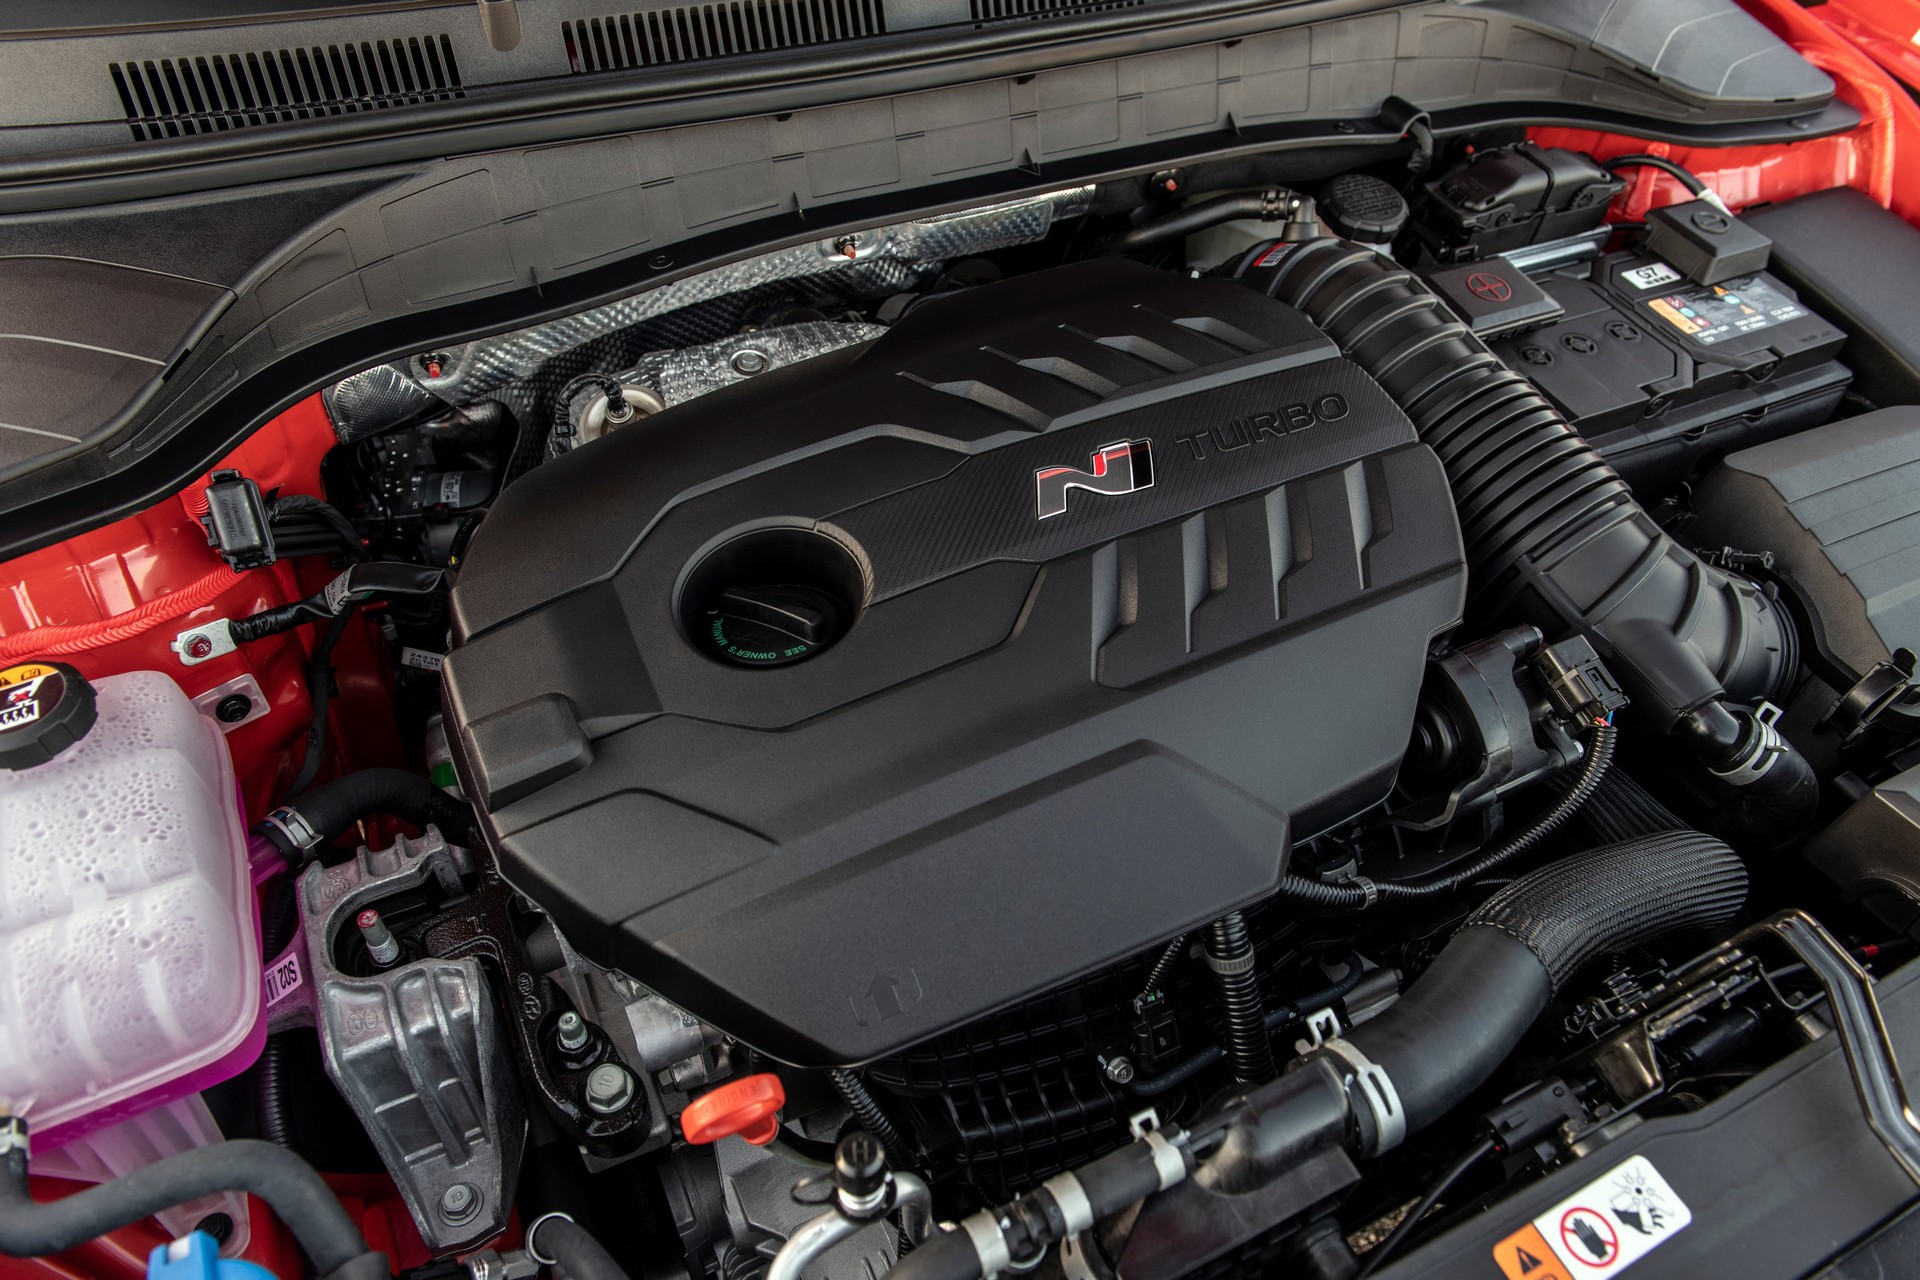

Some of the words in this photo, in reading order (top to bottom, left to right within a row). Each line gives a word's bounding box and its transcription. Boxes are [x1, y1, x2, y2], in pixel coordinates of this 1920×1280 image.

[1636, 267, 1658, 280] G7
[1034, 438, 1156, 521] N
[1175, 393, 1350, 460] TURBO
[712, 618, 729, 647] MANUAL
[727, 645, 777, 660] OWNER'S
[784, 644, 807, 657] SEE
[277, 960, 298, 990] S02
